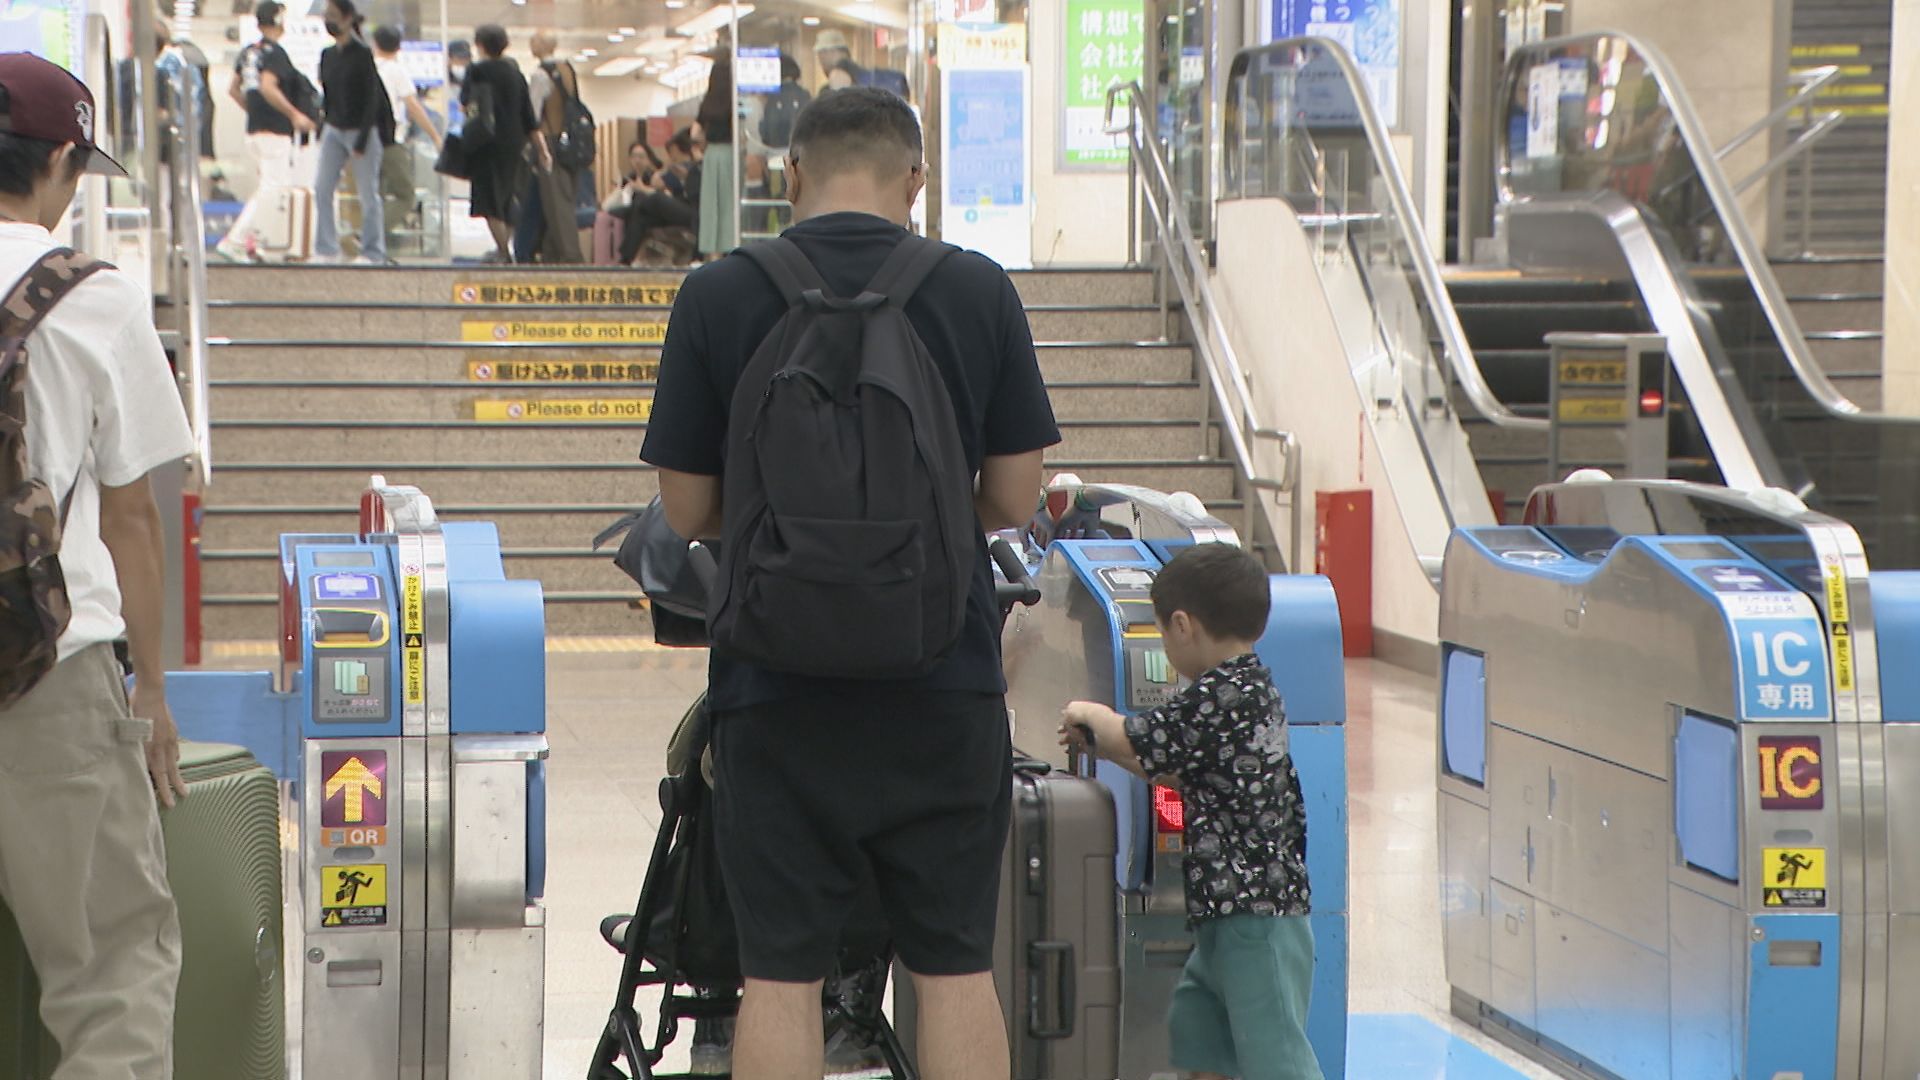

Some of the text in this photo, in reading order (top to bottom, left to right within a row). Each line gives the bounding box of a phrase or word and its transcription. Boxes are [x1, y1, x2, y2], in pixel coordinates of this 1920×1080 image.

[512, 322, 665, 338] Please do not rush
[526, 400, 583, 416] Please
[588, 400, 608, 416] do
[614, 401, 641, 416] not
[1752, 631, 1811, 677] IC
[1757, 684, 1815, 710] 専用
[1759, 747, 1822, 798] IC
[351, 829, 378, 844] QR
